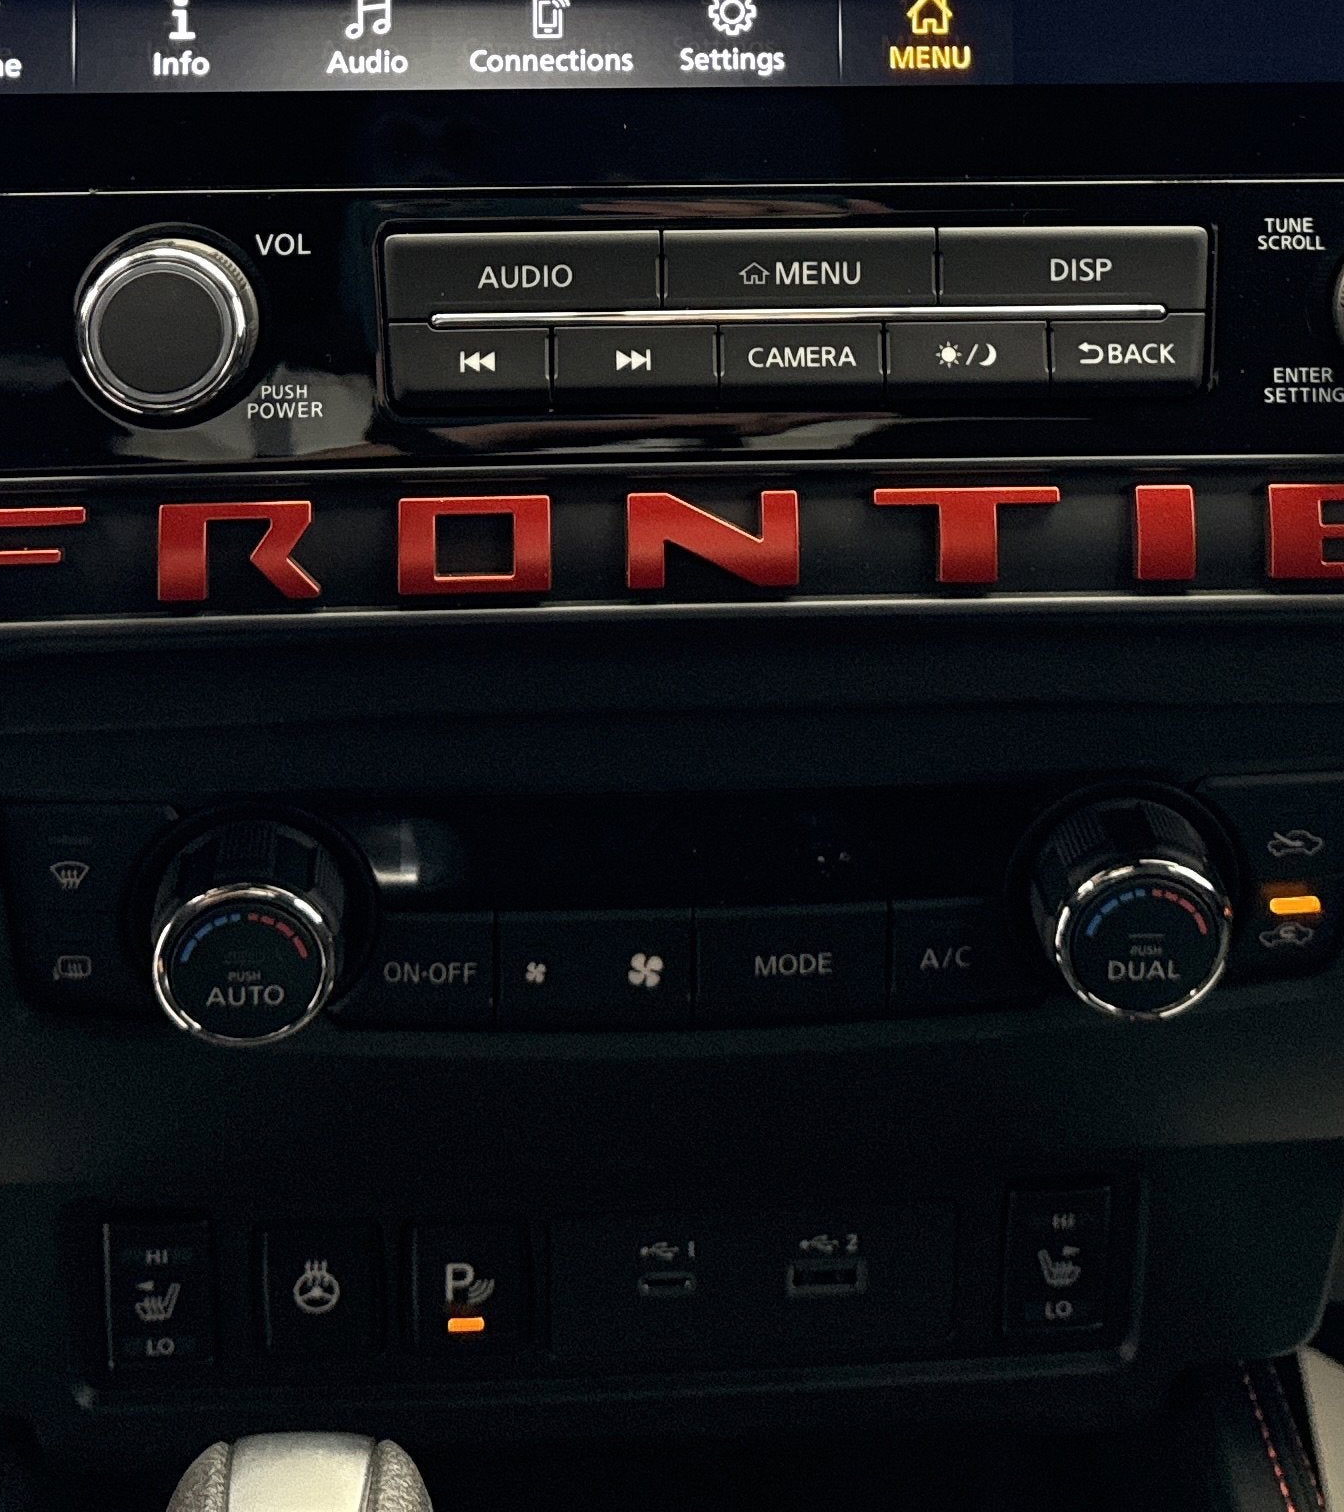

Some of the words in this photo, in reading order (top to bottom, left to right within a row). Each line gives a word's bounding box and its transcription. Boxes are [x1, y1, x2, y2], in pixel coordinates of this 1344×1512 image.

[152, 50, 210, 77] Info
[325, 49, 409, 75] Audio
[469, 47, 634, 73] Connections
[679, 46, 786, 77] Settings
[888, 45, 972, 71] MENU
[1264, 217, 1314, 234] TUNE
[254, 232, 312, 257] VOL
[1257, 234, 1327, 252] SCROLL
[477, 264, 574, 290] AUDIO
[774, 259, 863, 286] MENU
[1049, 257, 1113, 283] DISP
[746, 345, 857, 370] CAMERA
[1107, 341, 1176, 366] BACK
[1272, 367, 1334, 385] ENTER
[260, 384, 309, 401] PUSH
[246, 402, 324, 420] POWER
[753, 952, 833, 977] MODE
[918, 944, 973, 972] A/C
[1106, 958, 1182, 984] DUAL
[205, 983, 287, 1009] AUTO
[1051, 1212, 1077, 1231] HI
[144, 1248, 169, 1265] HI
[1043, 1299, 1075, 1321] LO
[144, 1336, 176, 1358] LO
